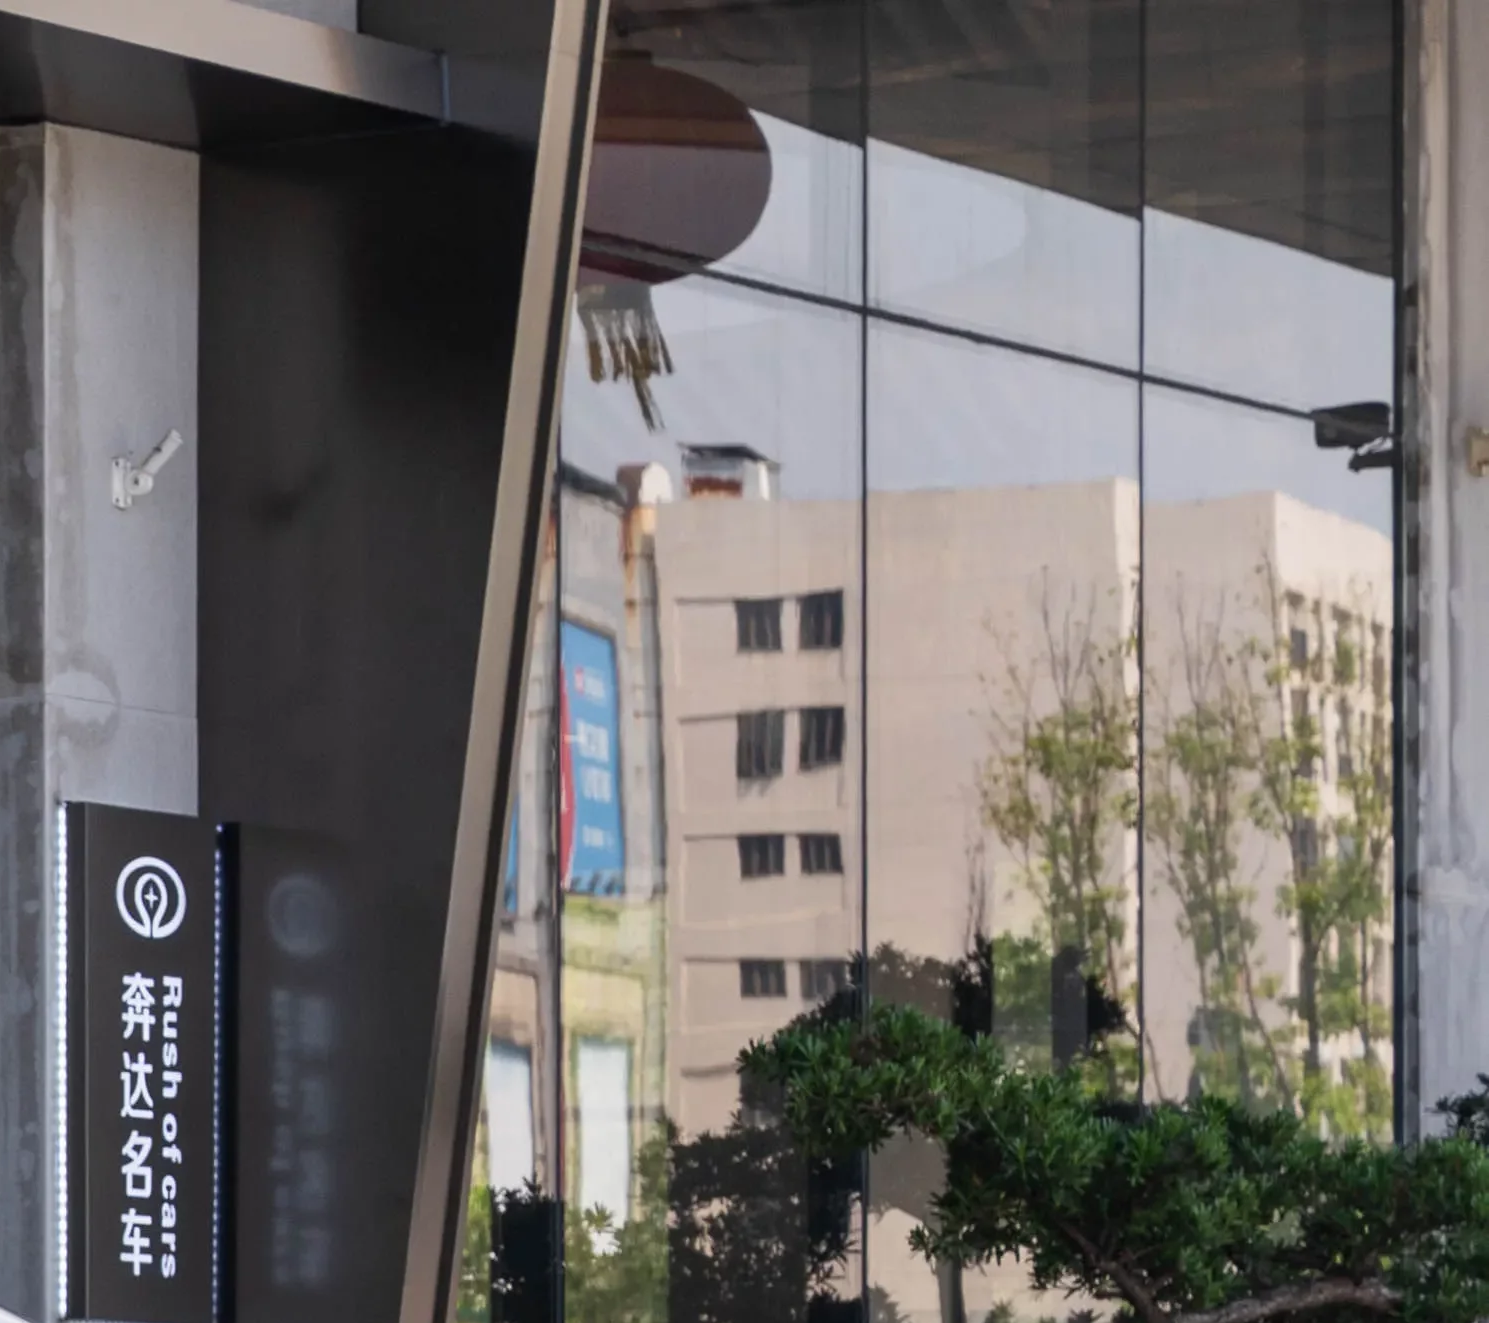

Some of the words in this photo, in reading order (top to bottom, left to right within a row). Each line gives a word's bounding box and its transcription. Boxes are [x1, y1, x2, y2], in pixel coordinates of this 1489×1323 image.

[160, 974, 184, 1098] Rush
[119, 971, 157, 1279] 奔达名车
[160, 1114, 183, 1166] of
[159, 1176, 180, 1279] cars
